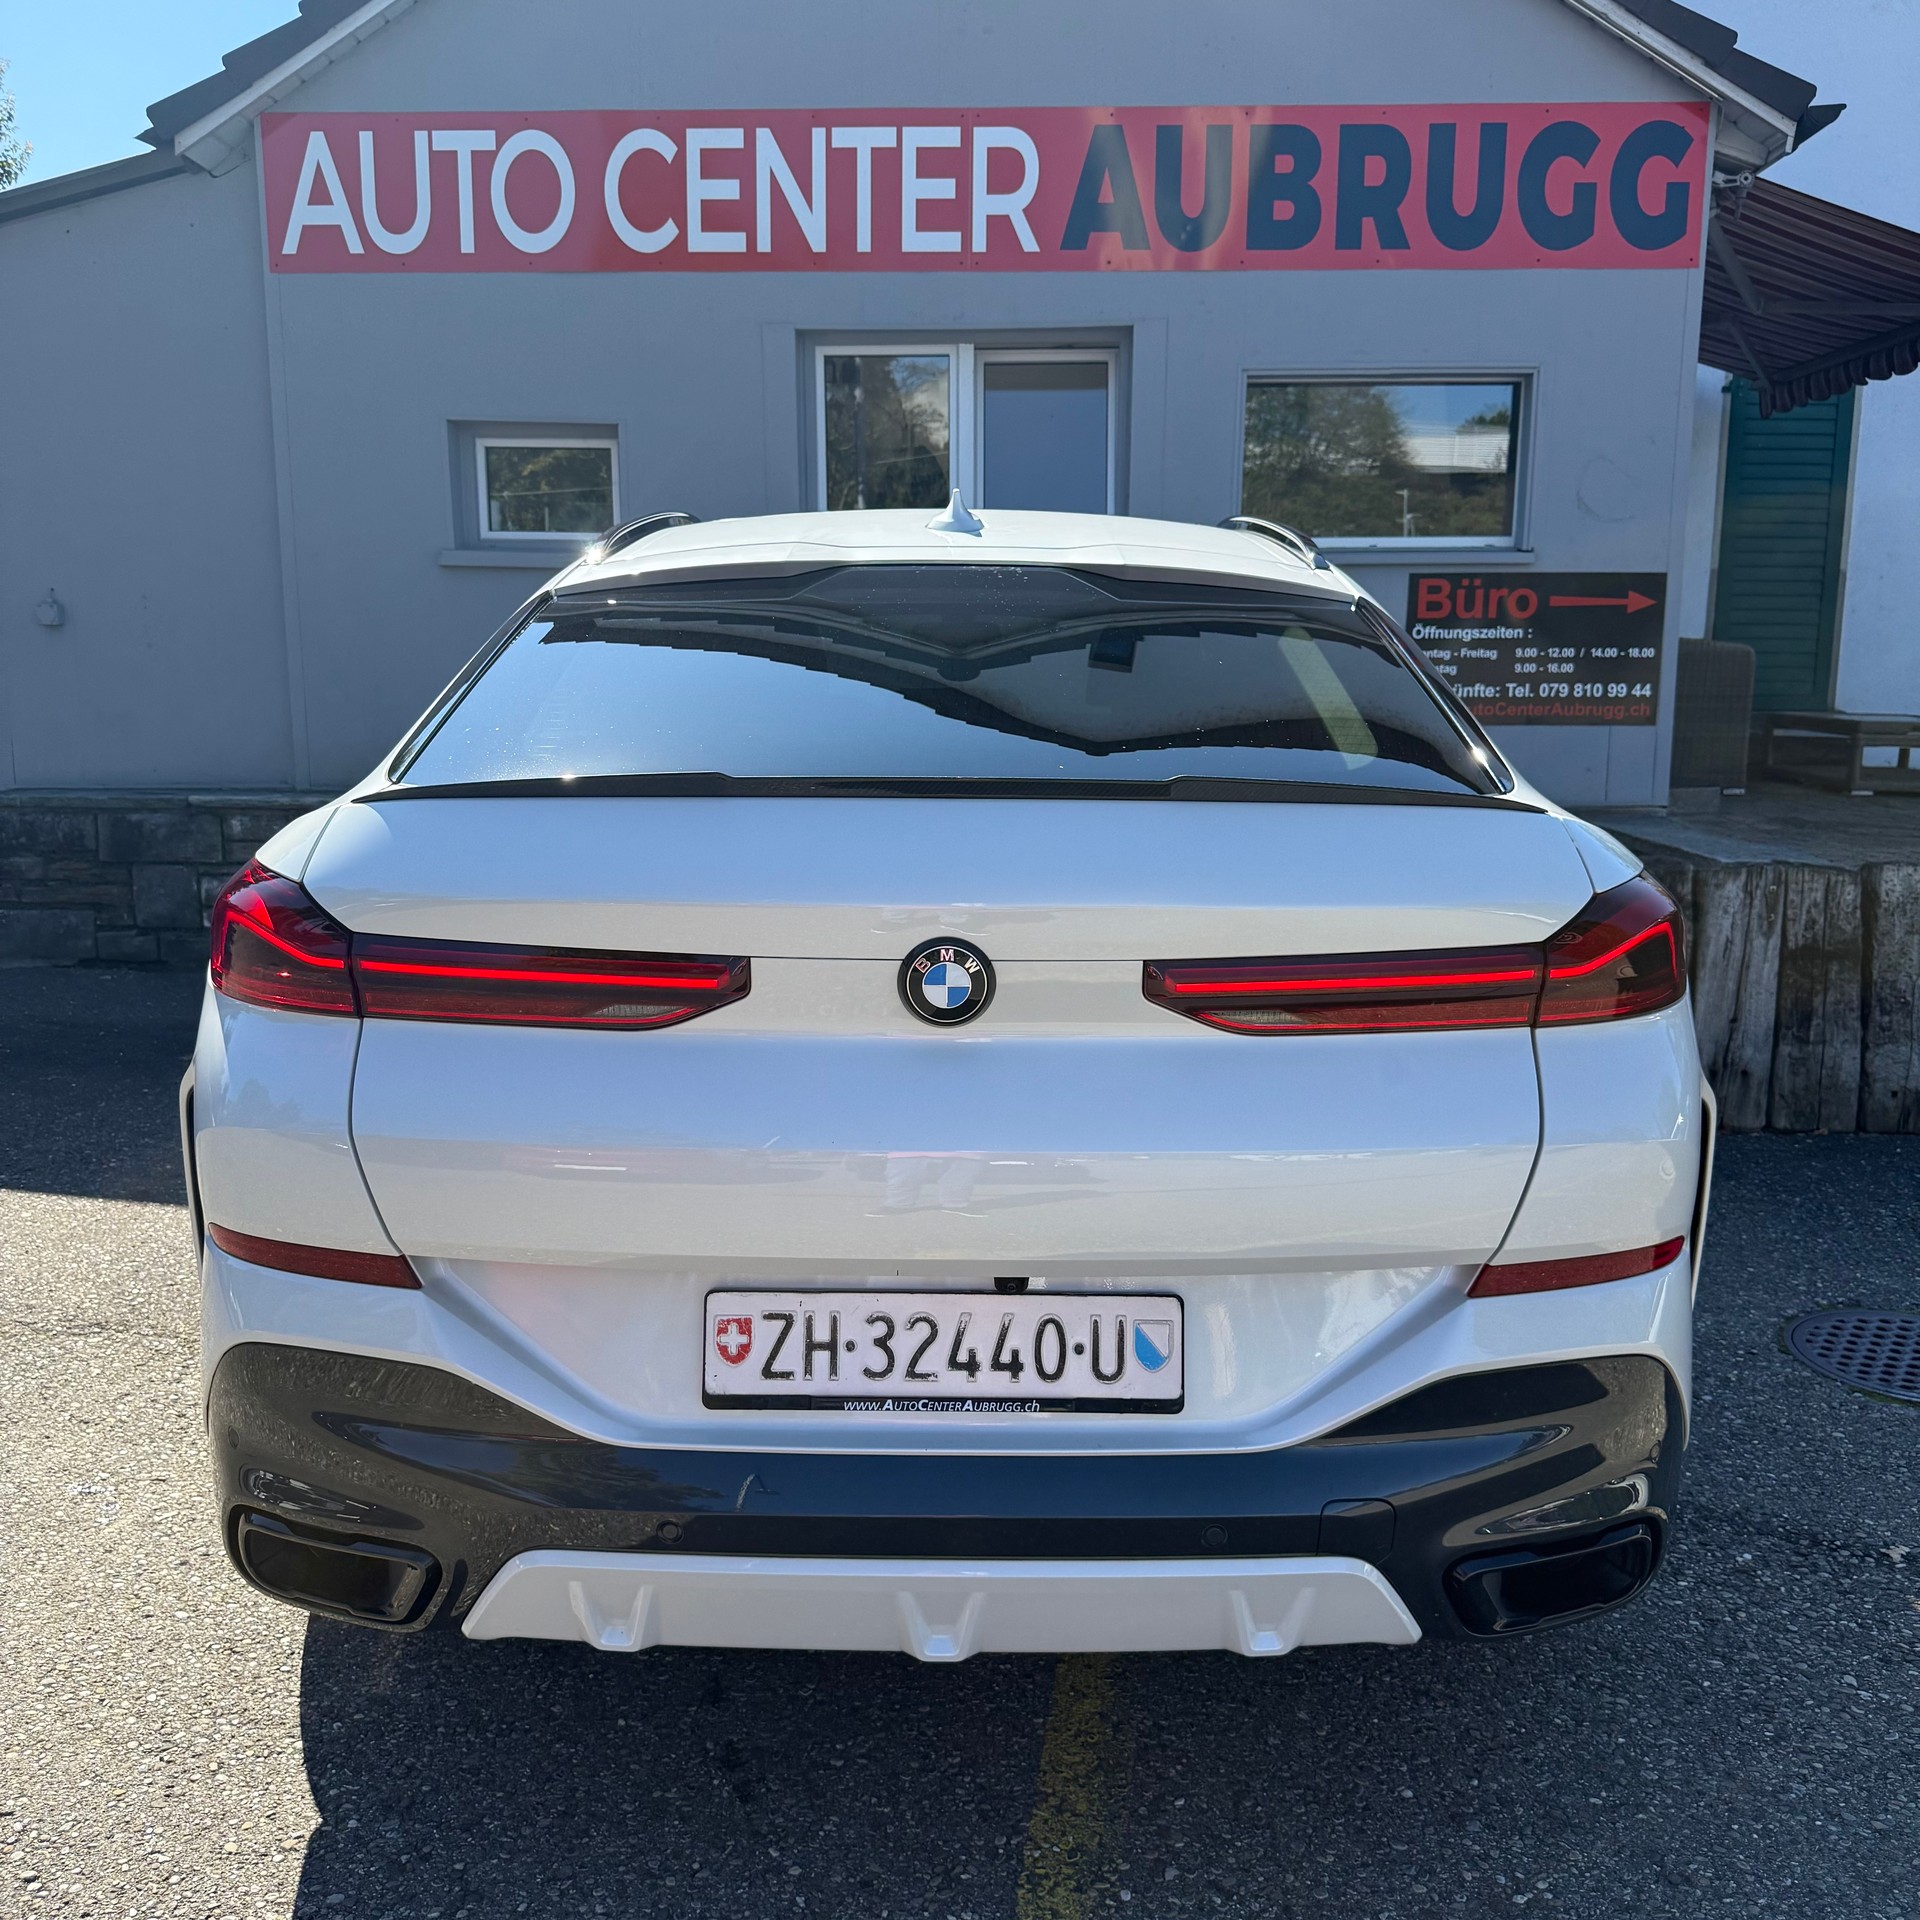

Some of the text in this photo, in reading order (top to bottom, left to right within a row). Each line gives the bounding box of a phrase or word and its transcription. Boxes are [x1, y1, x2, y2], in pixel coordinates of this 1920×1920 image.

[281, 120, 1695, 255] AUTO CENTER AUBRUGG
[1416, 578, 1538, 619] Büro
[1412, 623, 1523, 641] Öffnungszeiten
[1423, 648, 1451, 660] ntag
[1460, 648, 1498, 660] Freitag
[1515, 648, 1537, 658] 9.00
[1548, 648, 1575, 658] 12.00
[1591, 648, 1617, 658] 14.00
[1628, 648, 1655, 658] 18.00
[1514, 663, 1537, 673] 9.00
[1547, 663, 1574, 673] 16.00
[1506, 683, 1534, 698] Tel.
[1539, 683, 1569, 698] 079
[1573, 683, 1603, 698] 810
[1607, 683, 1627, 698] 99
[1631, 683, 1652, 698] 44
[1471, 702, 1651, 719] utoCenterAubrugg.ch
[915, 949, 980, 974] BMW
